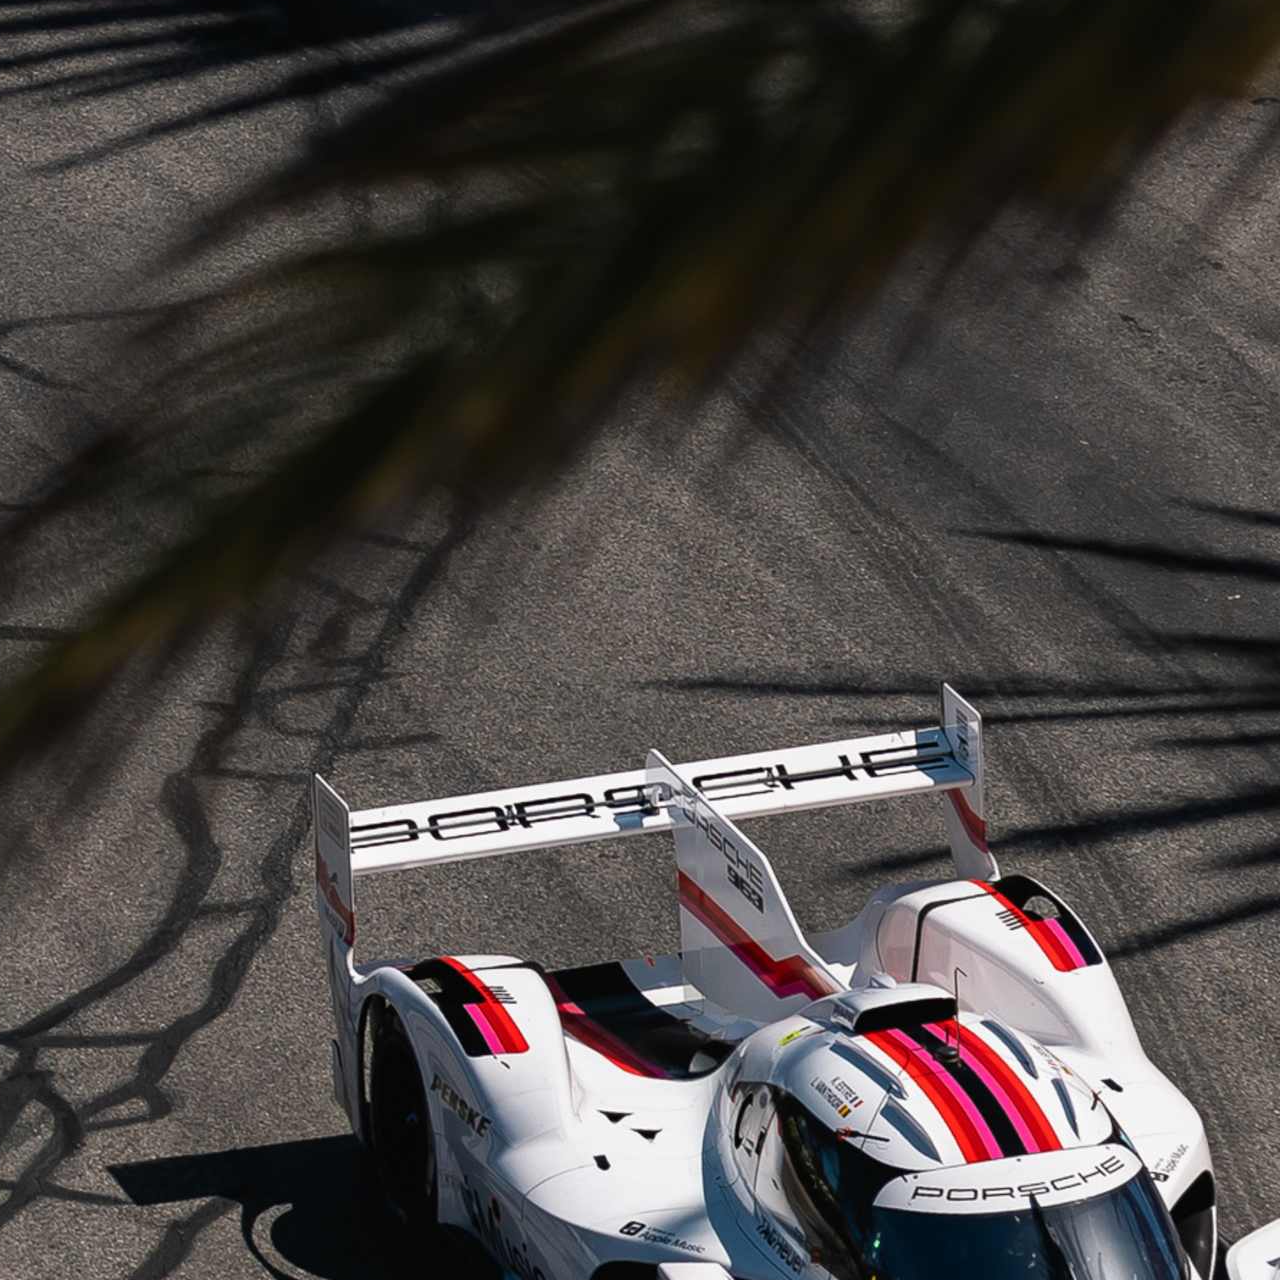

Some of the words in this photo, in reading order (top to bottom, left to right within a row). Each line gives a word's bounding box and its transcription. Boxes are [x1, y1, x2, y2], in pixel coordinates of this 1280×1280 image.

[682, 803, 764, 894] ORSCHE
[727, 866, 765, 914] 963
[430, 1073, 492, 1139] PENSKE
[911, 1155, 1126, 1203] PORSCHE
[639, 1231, 671, 1244] Apple
[671, 1238, 706, 1254] Music
